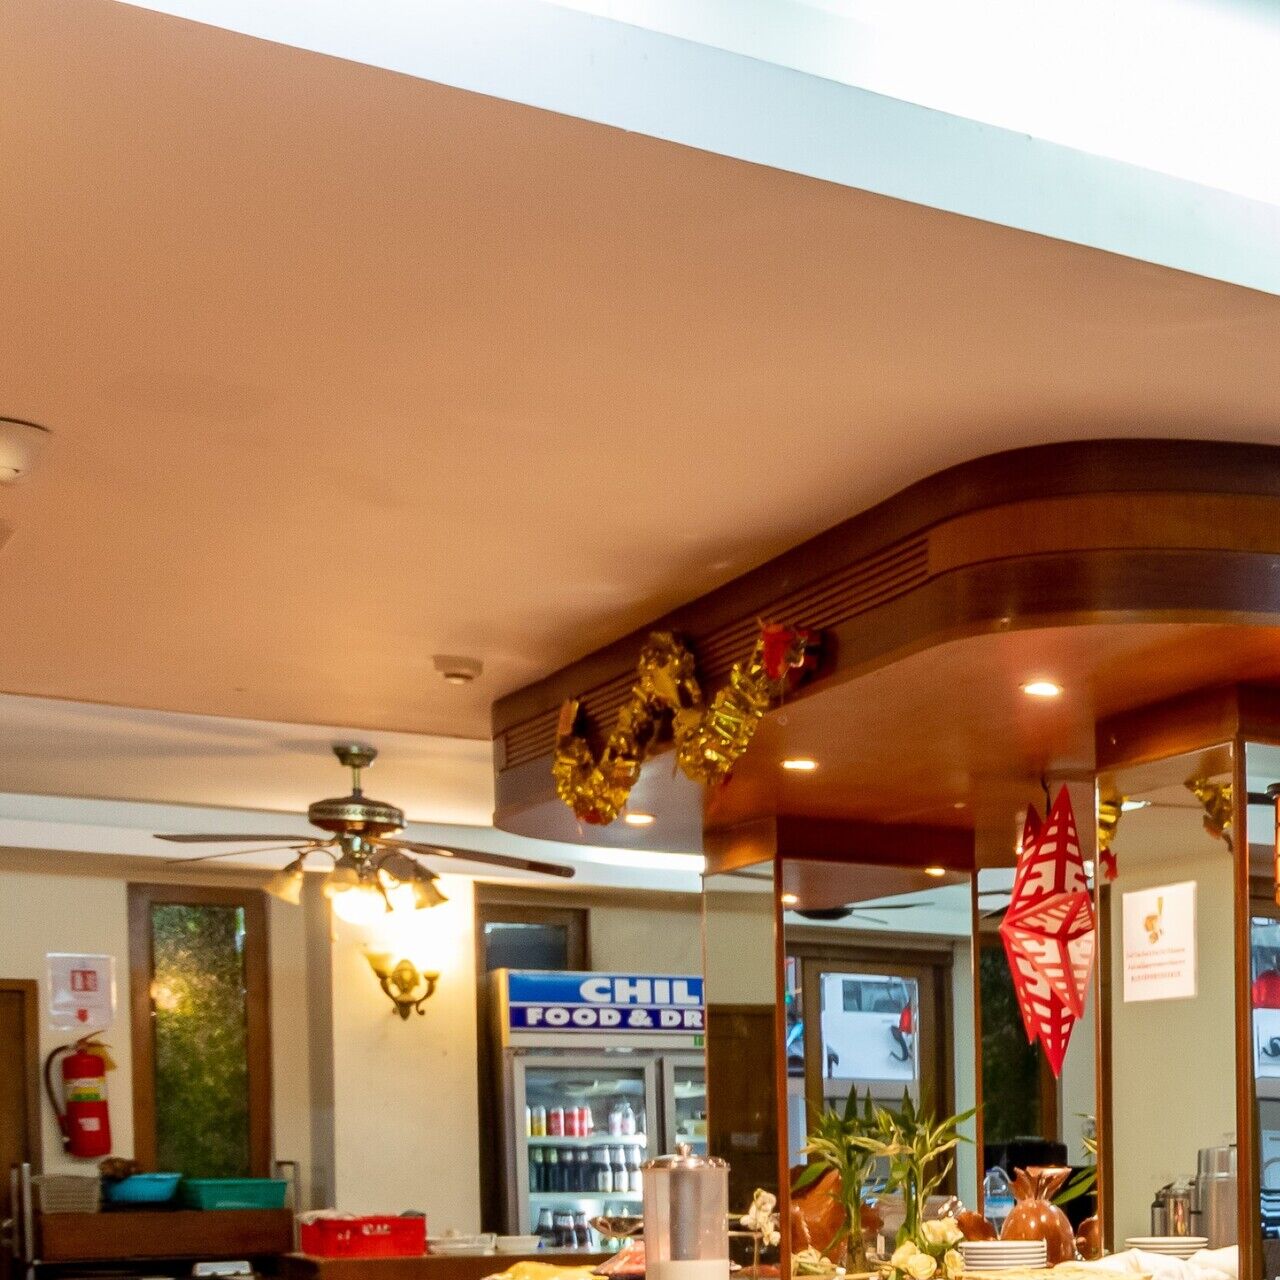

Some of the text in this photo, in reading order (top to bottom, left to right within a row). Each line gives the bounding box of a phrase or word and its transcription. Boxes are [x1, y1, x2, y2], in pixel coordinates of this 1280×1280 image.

[579, 977, 704, 1004] CHIL
[526, 1007, 622, 1026] FOOD
[628, 1010, 654, 1027] &
